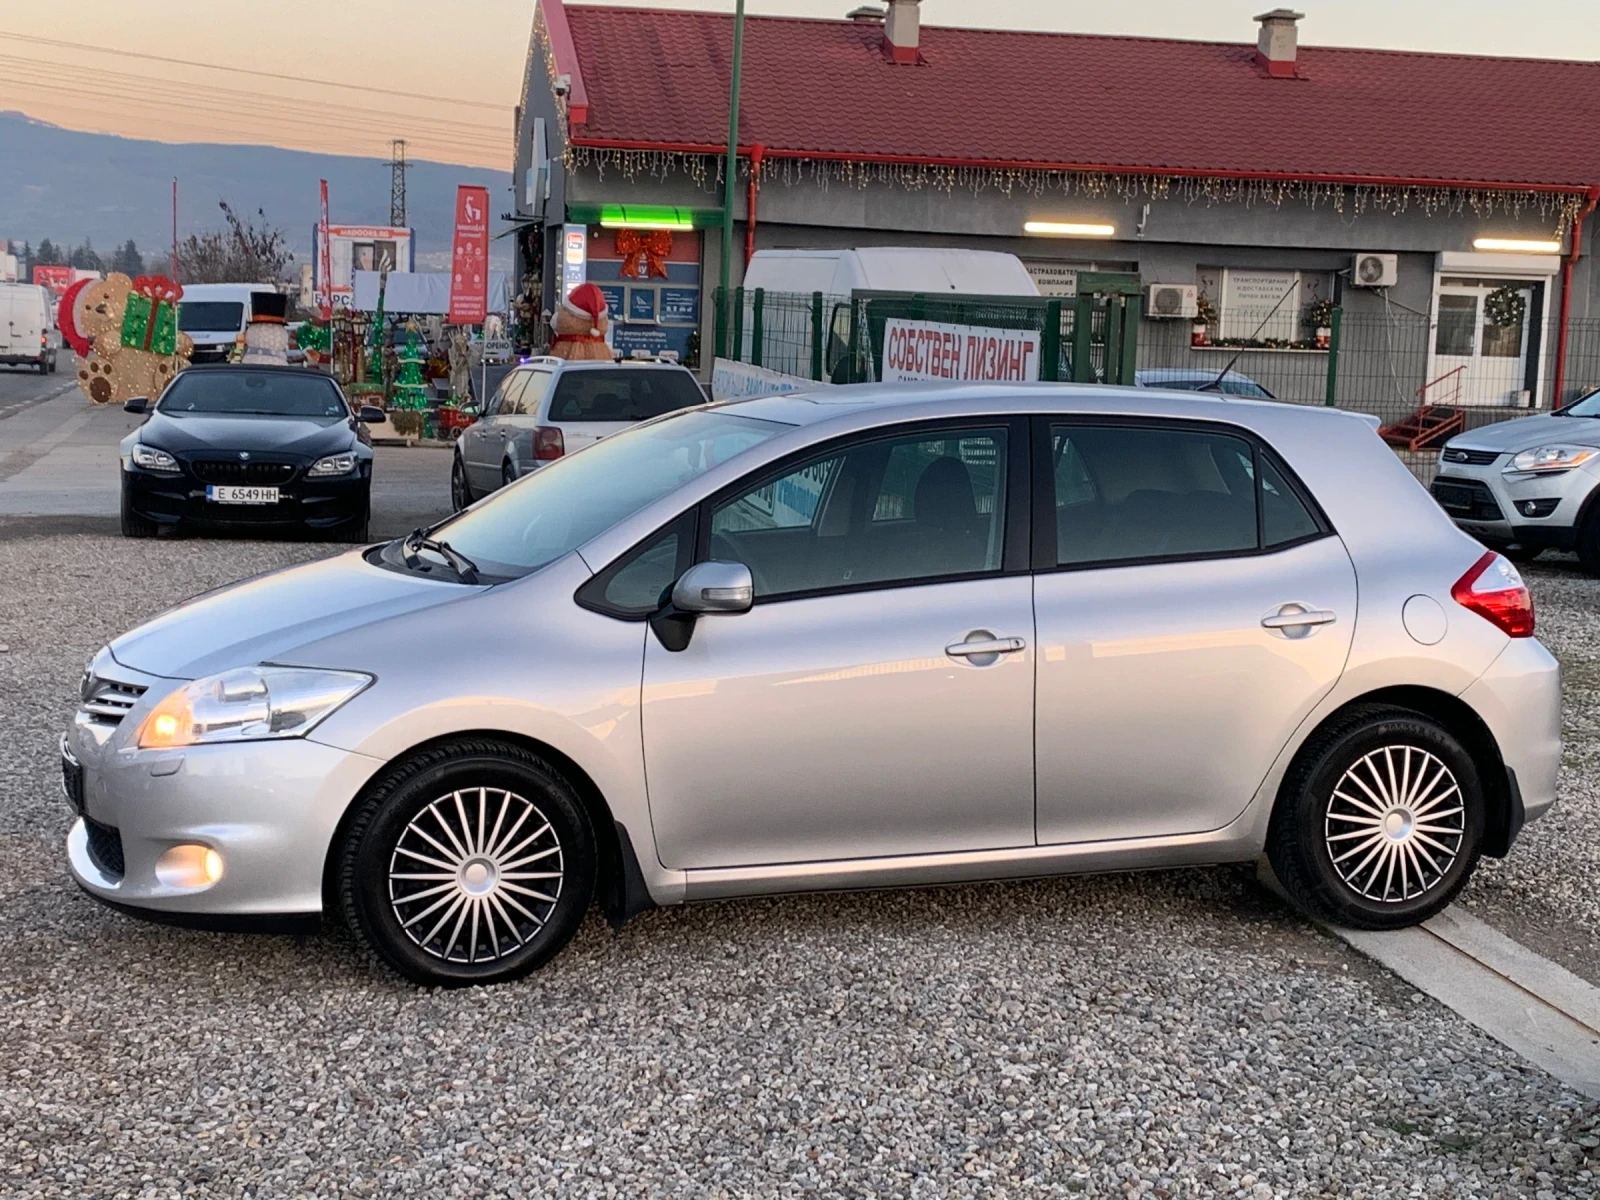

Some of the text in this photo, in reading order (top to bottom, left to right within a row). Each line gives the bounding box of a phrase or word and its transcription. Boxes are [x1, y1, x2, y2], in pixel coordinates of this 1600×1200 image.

[888, 326, 1034, 381] СОБСТВЕН ЛИЗИНГ
[219, 488, 226, 499] E
[231, 489, 259, 500] 6549
